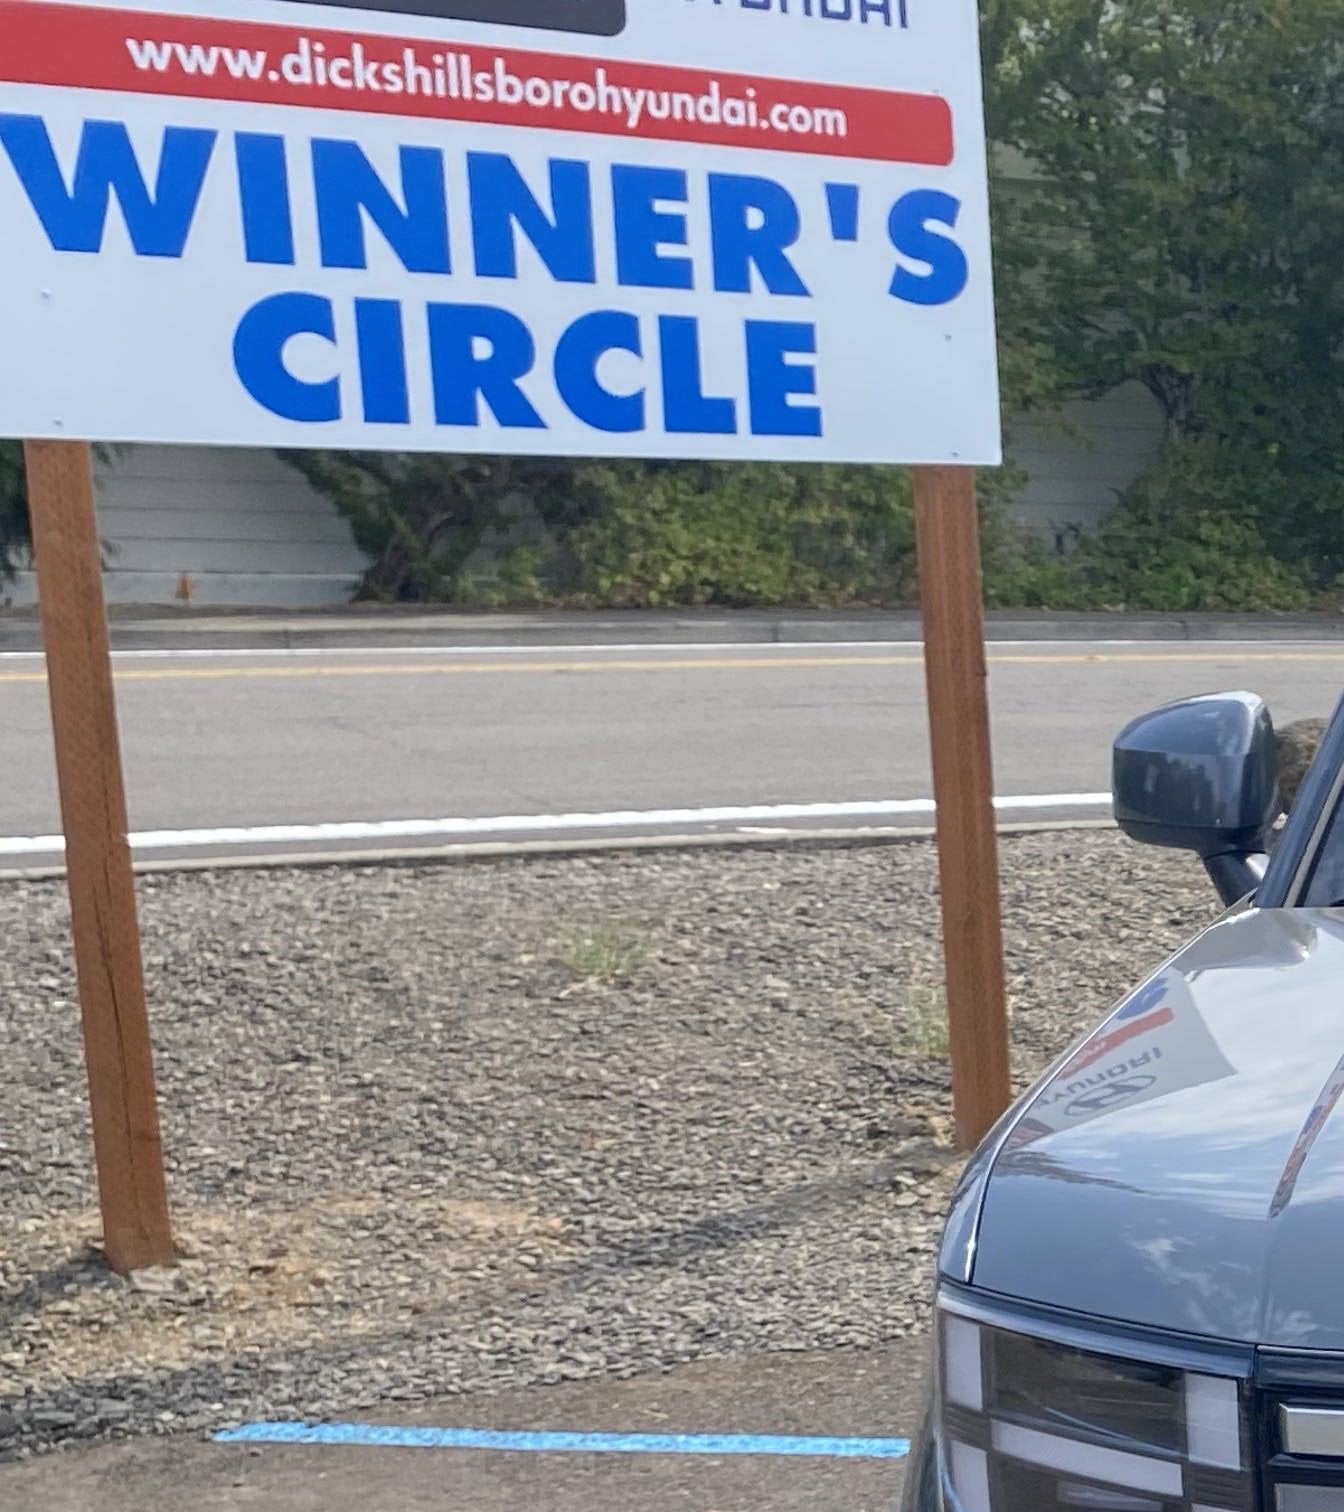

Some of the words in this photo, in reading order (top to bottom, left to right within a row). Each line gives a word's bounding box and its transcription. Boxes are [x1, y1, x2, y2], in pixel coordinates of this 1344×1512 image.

[127, 36, 848, 138] www.dickshillsborohyundai.com
[1, 112, 969, 307] WINNER'S
[232, 290, 824, 438] CIRCLE
